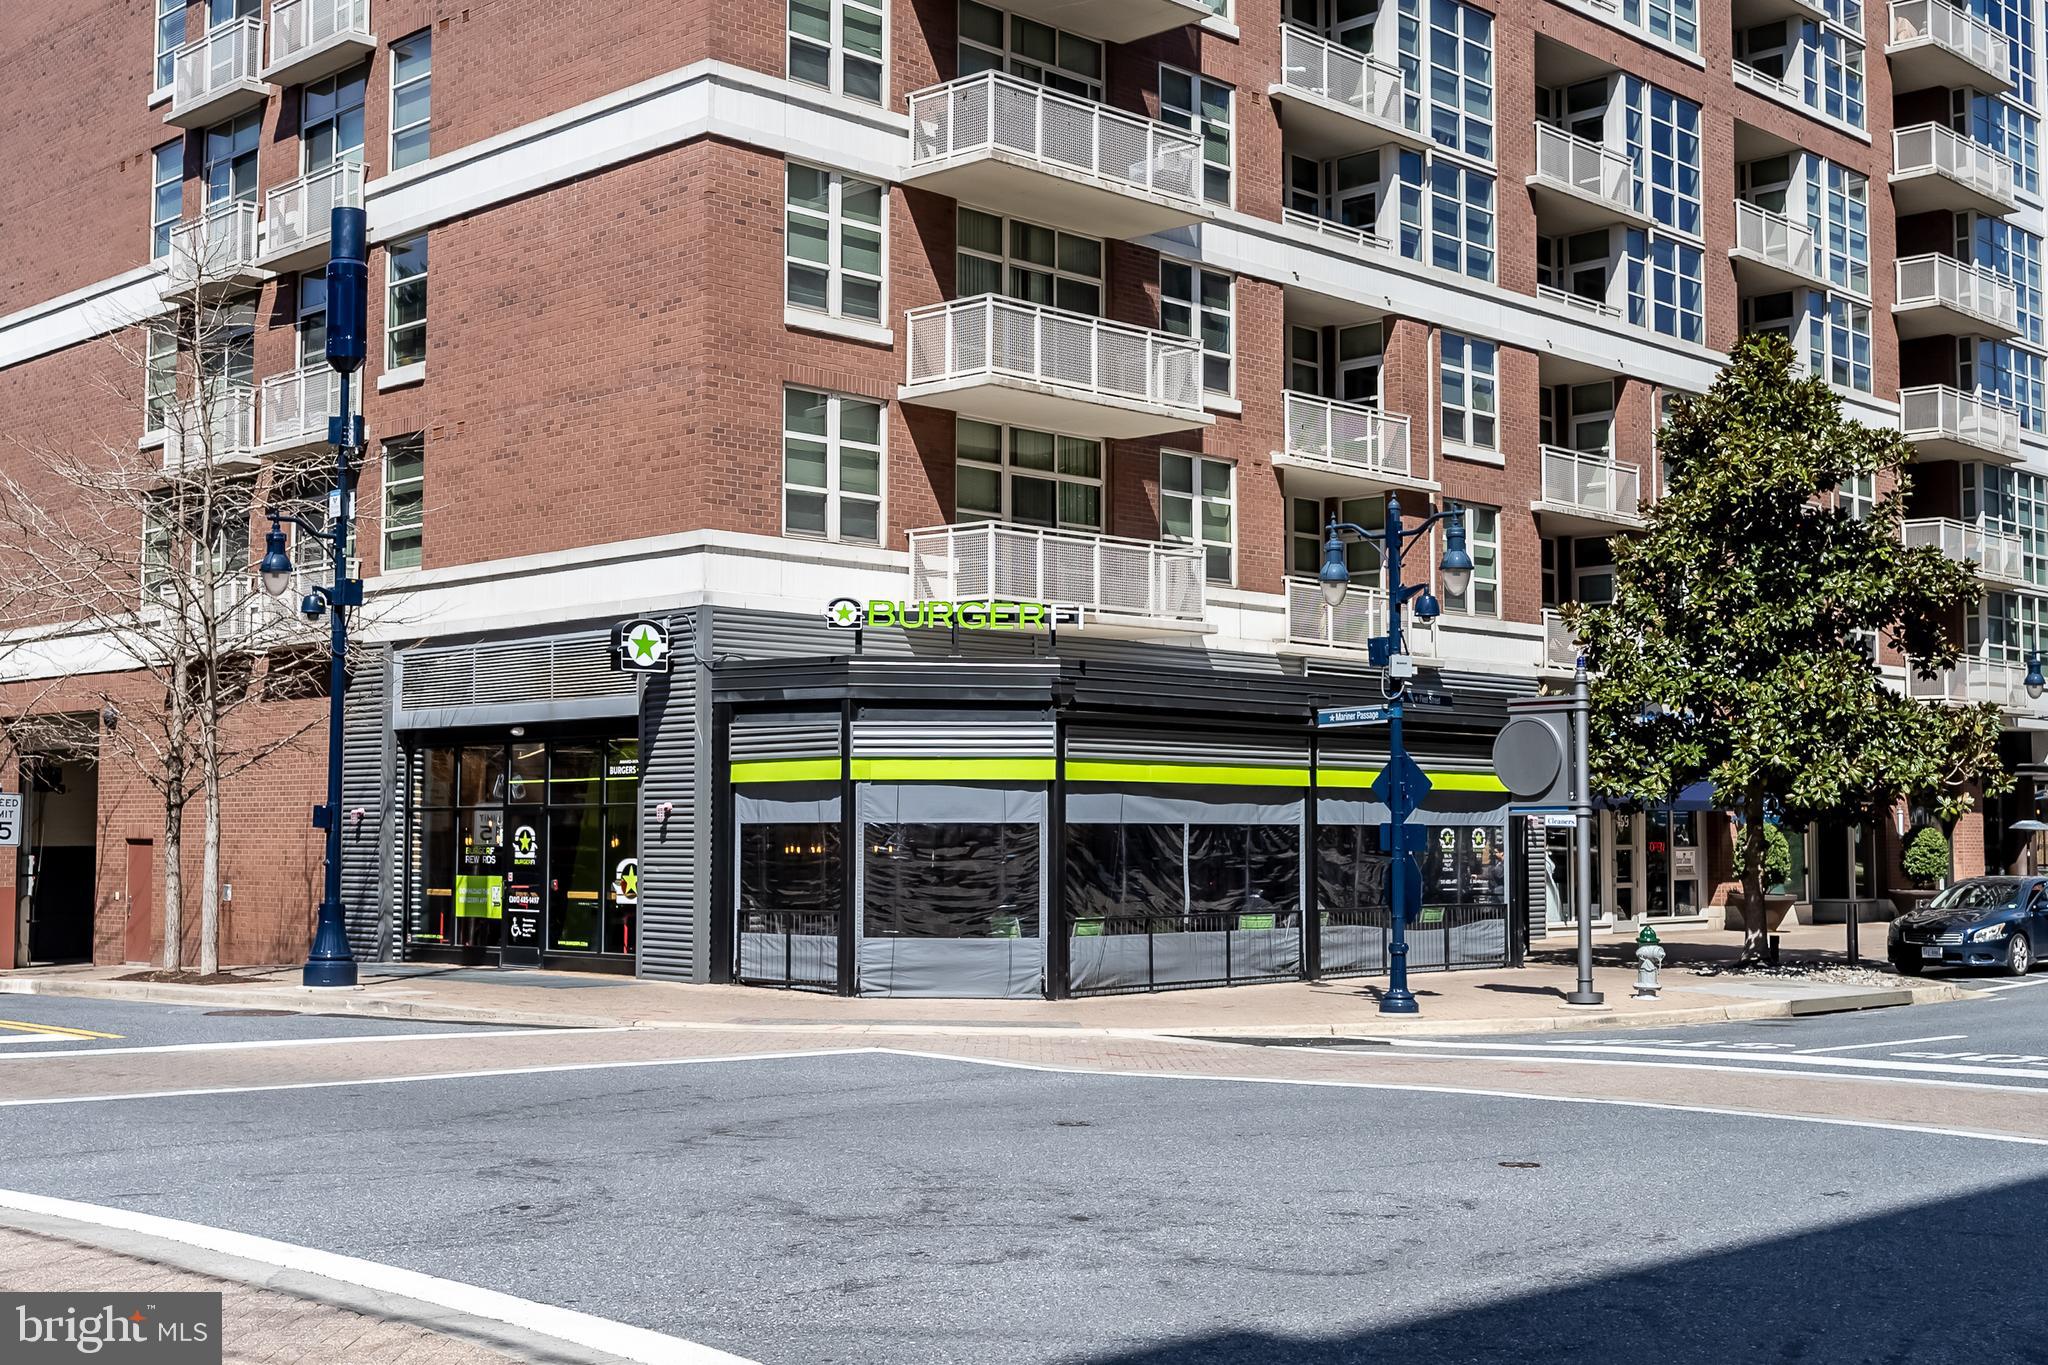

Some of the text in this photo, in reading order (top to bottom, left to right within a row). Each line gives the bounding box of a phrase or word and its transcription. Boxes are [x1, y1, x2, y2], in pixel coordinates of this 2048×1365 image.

[867, 600, 1085, 630] BURGERFI
[1335, 710, 1379, 721] Mariner Passage
[610, 766, 637, 775] BURGERS
[0, 799, 19, 807] EED
[0, 810, 14, 818] MIT
[1547, 817, 1575, 825] Cleaners
[0, 822, 12, 840] 5
[465, 855, 496, 864] REWRDS
